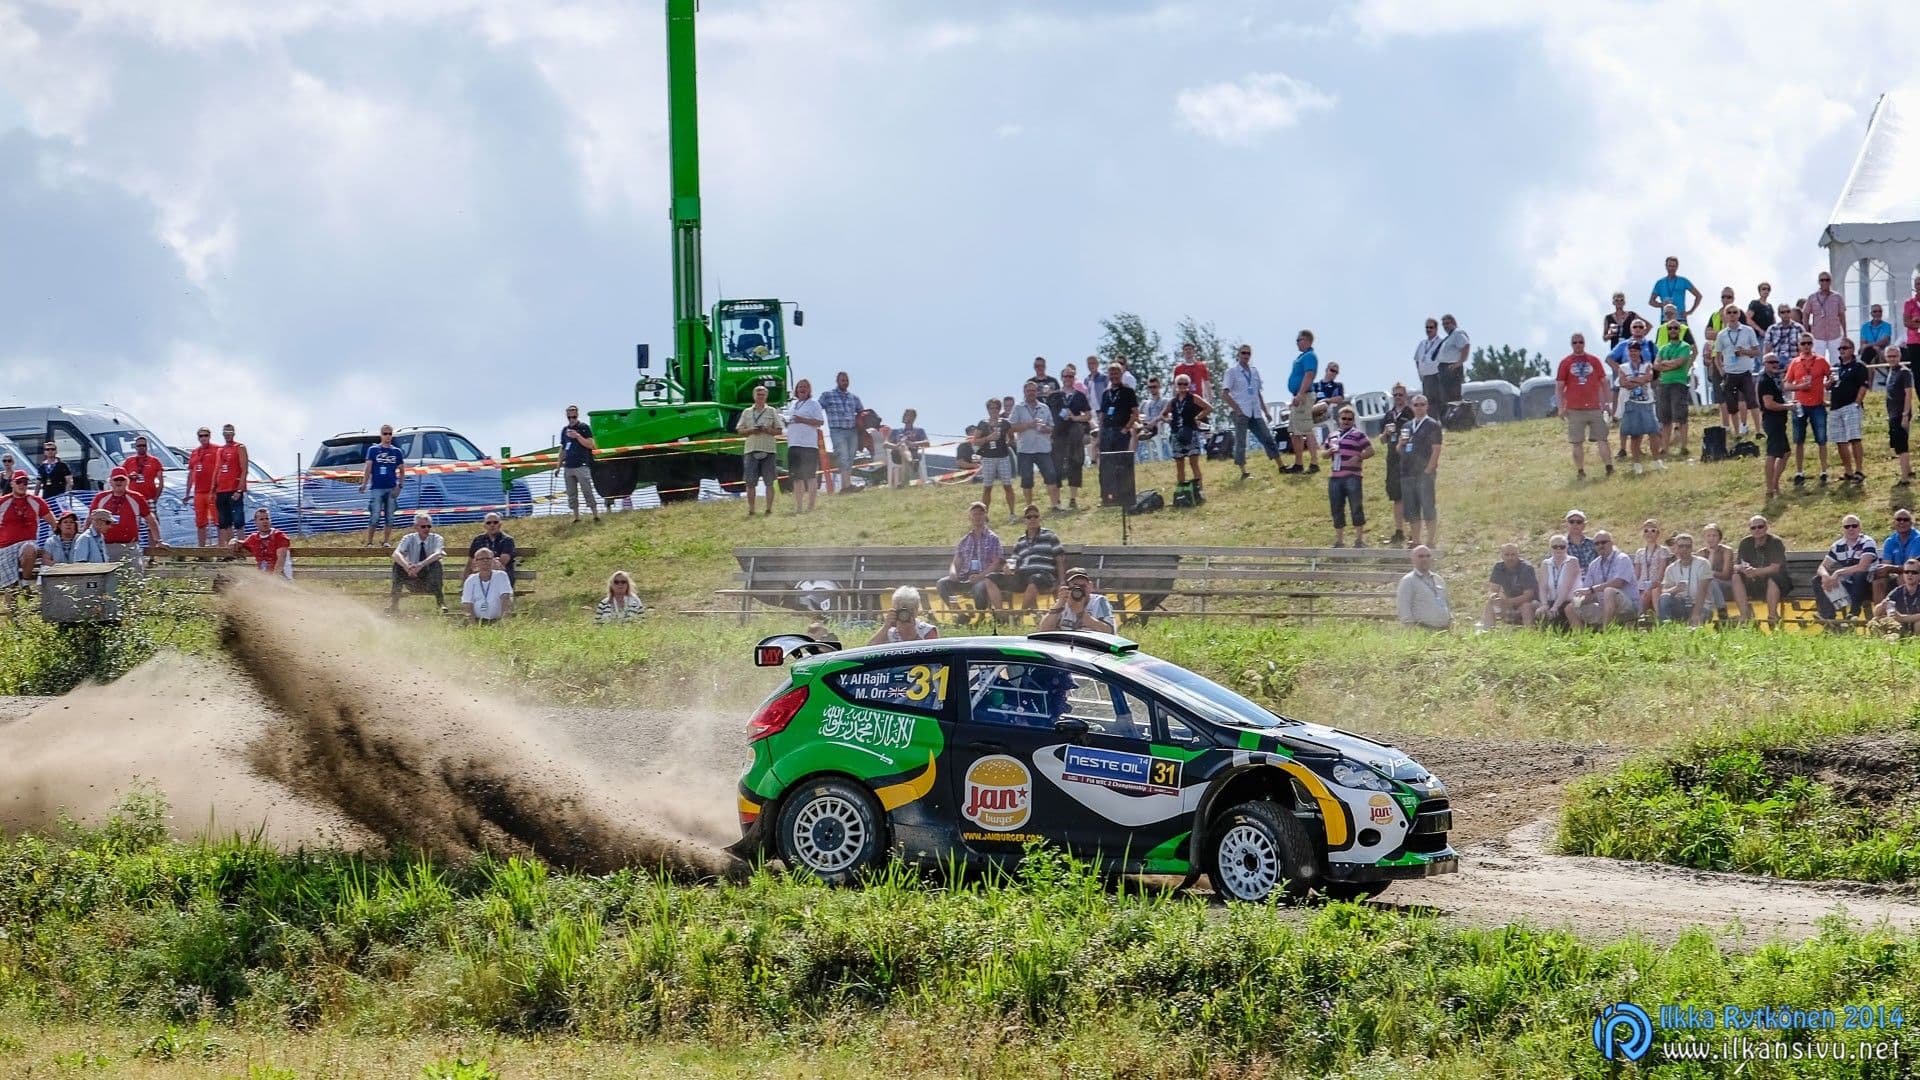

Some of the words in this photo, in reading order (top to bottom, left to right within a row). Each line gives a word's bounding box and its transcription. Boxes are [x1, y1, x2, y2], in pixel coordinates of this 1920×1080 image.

[840, 674, 848, 685] Y.
[905, 664, 951, 702] 31
[855, 688, 868, 699] M.
[871, 687, 889, 699] Orr
[1069, 755, 1120, 771] NESTE
[1121, 762, 1143, 775] OIL
[1154, 763, 1176, 785] 31
